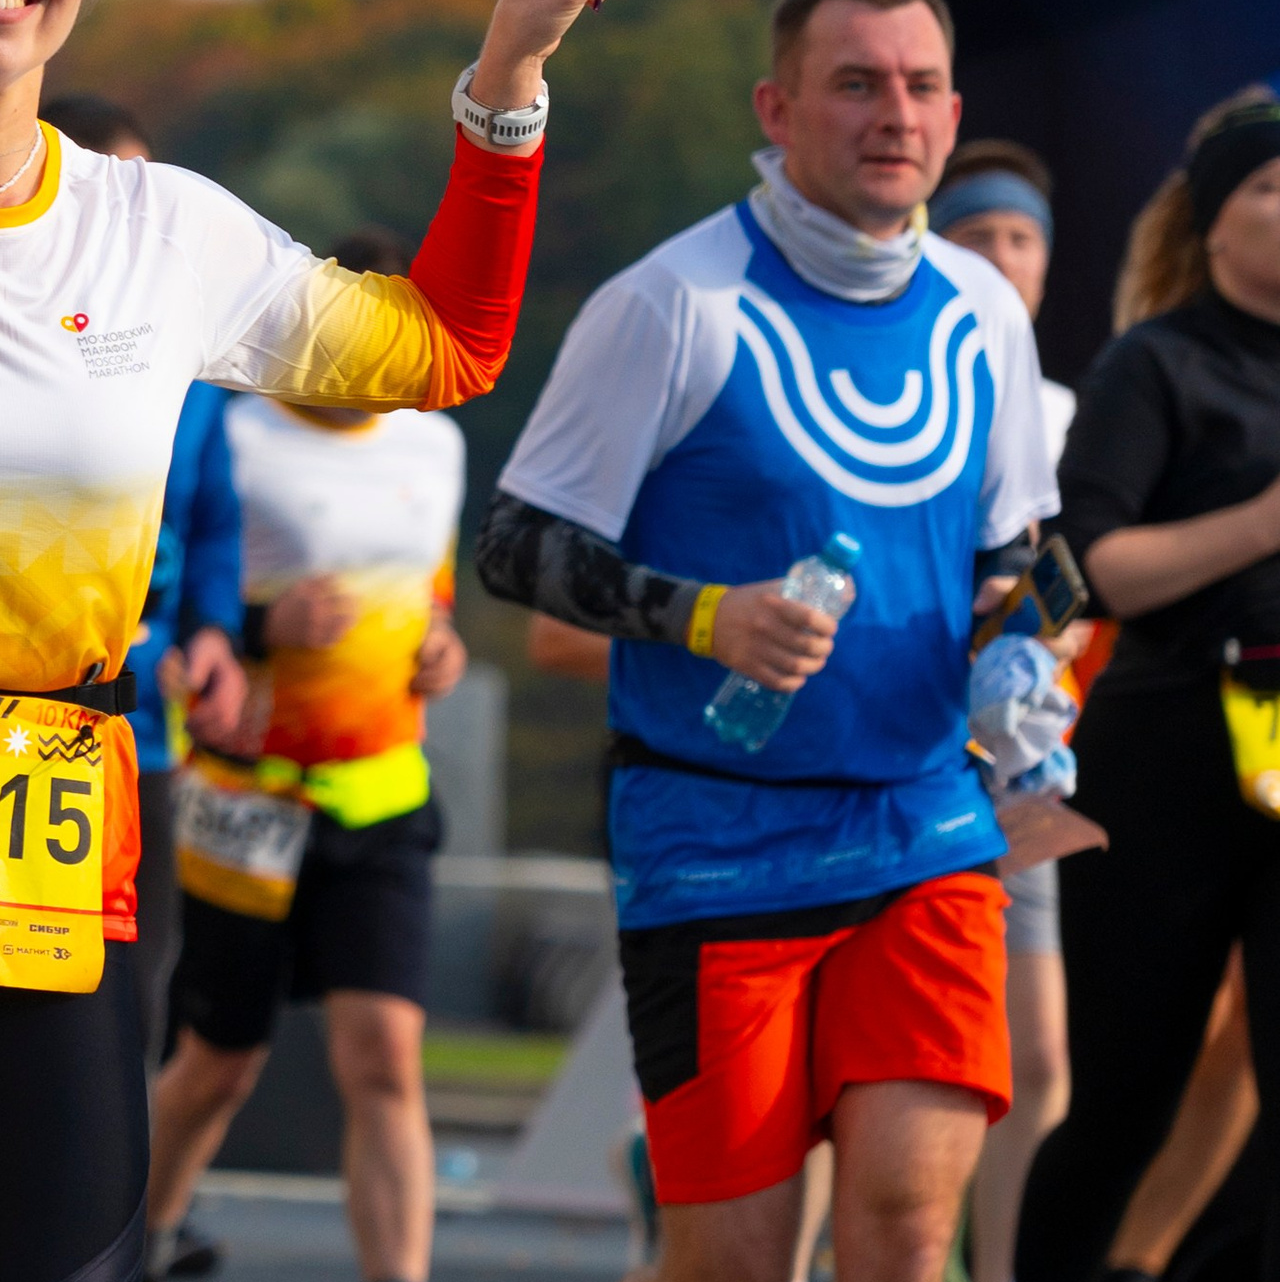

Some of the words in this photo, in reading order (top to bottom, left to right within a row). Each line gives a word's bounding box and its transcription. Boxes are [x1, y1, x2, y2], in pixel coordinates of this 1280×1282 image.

[76, 322, 154, 346] МОСКОВСКИЙ
[80, 341, 138, 358] МАРАФОН
[84, 353, 134, 368] MOSCOW
[88, 361, 150, 379] MARATHON
[36, 703, 58, 726] 10
[29, 924, 70, 935] СИБУР
[16, 947, 50, 956] МАГНИТ
